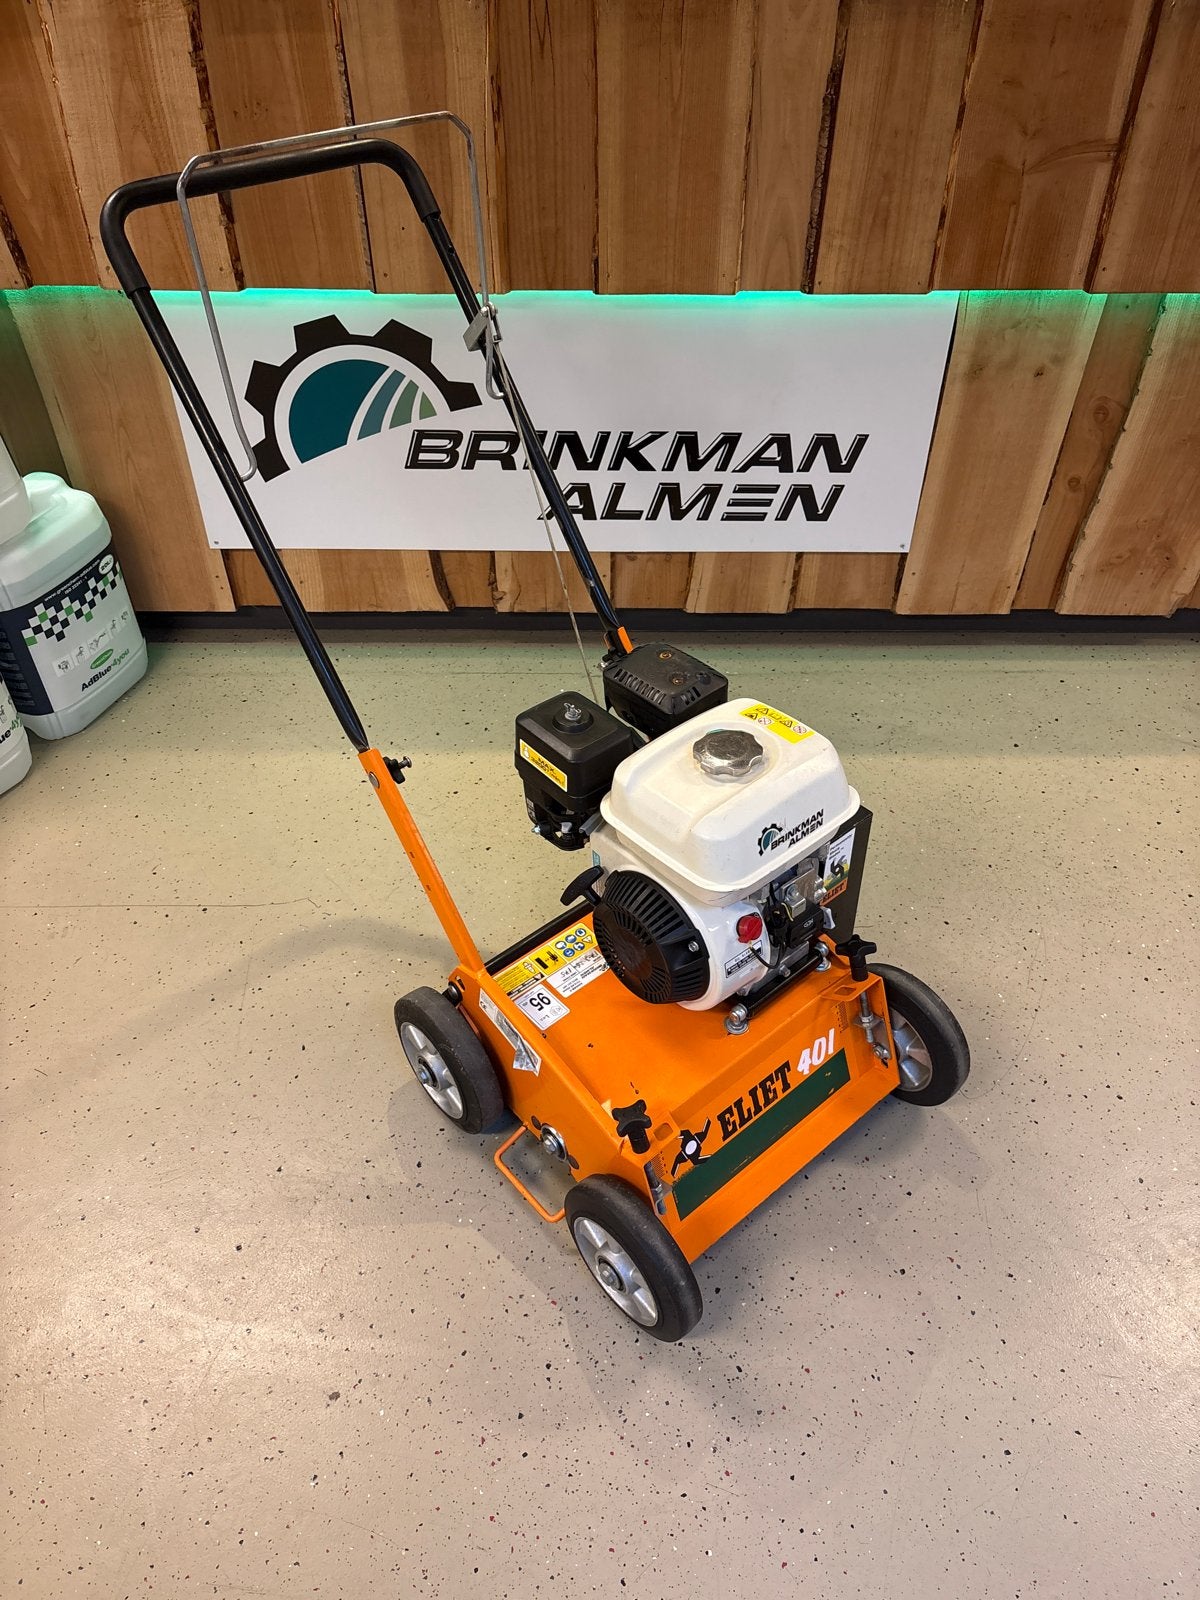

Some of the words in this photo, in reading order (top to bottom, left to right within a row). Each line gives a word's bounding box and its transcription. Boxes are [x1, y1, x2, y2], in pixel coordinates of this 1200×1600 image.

[537, 482, 845, 522] ALMEN
[770, 808, 824, 851] BRINKMAN
[787, 817, 824, 849] ALMEN
[529, 991, 552, 1012] 95
[716, 1060, 792, 1142] ELIET
[796, 1028, 835, 1076] 401
